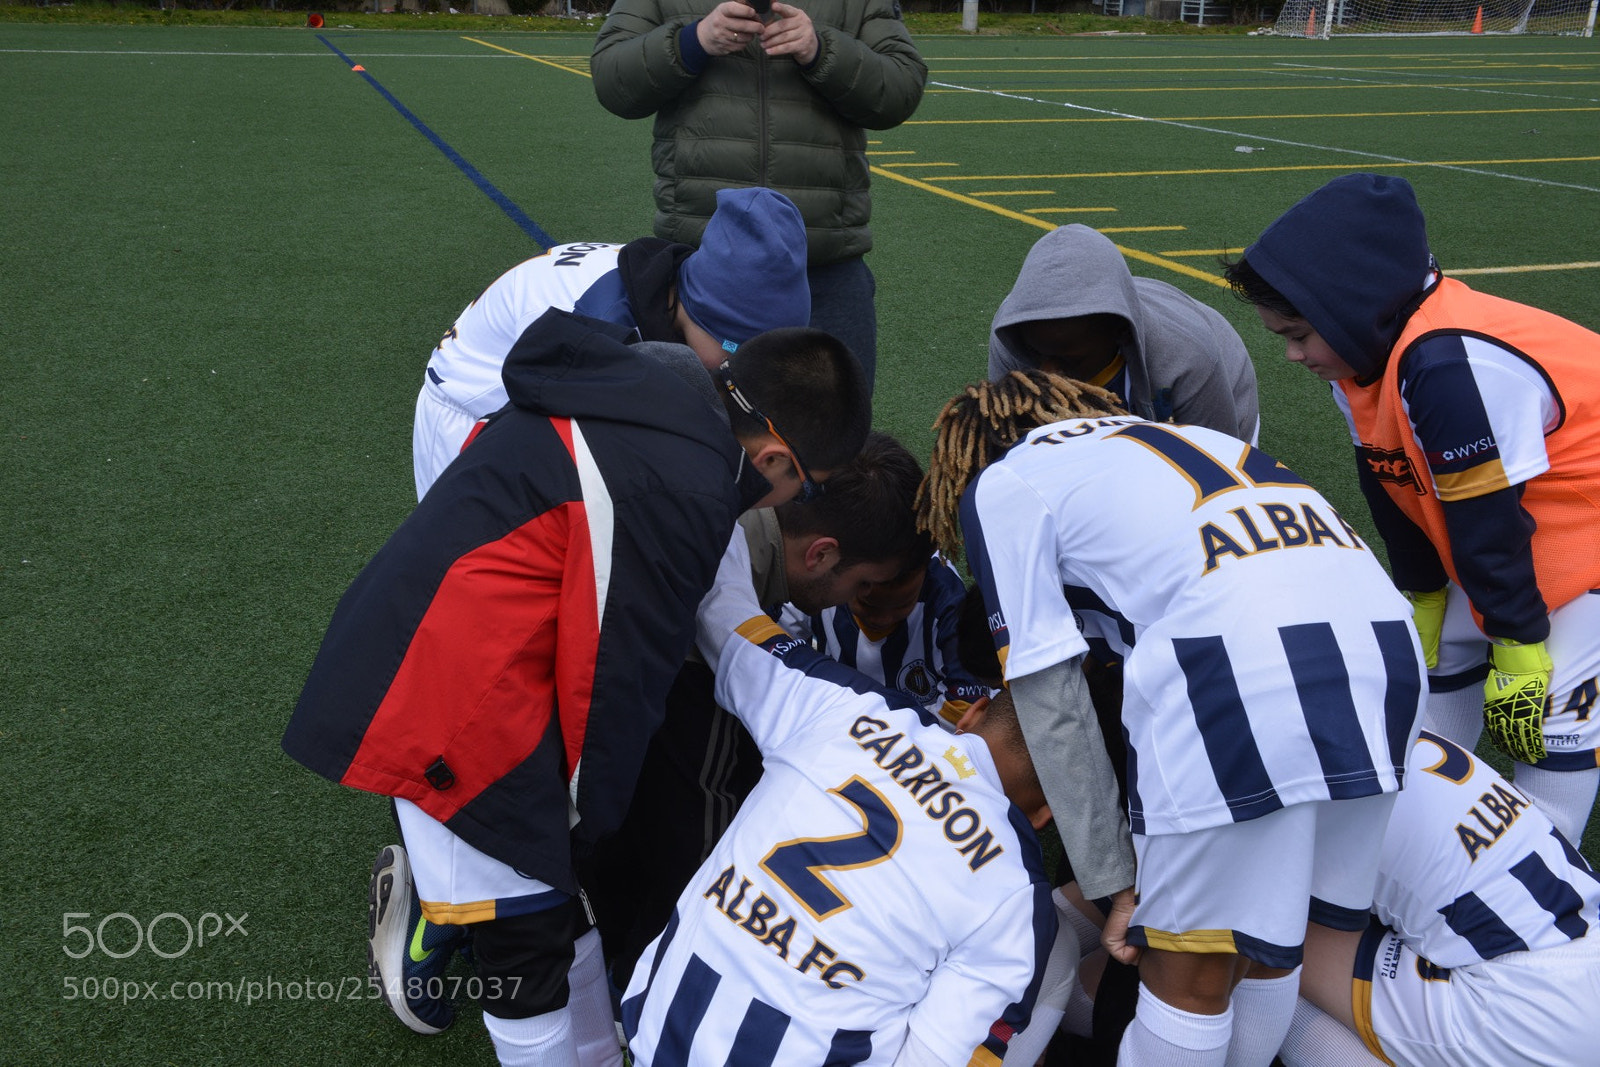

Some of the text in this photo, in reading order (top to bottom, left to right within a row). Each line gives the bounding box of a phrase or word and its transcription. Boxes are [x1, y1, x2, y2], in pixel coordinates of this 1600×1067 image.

[1453, 436, 1497, 458] WYSL
[1199, 502, 1352, 577] ALBA
[848, 715, 1004, 873] GARRISON
[1454, 783, 1529, 863] ALBA
[758, 773, 904, 923] 2
[703, 864, 867, 989] ALBA FC
